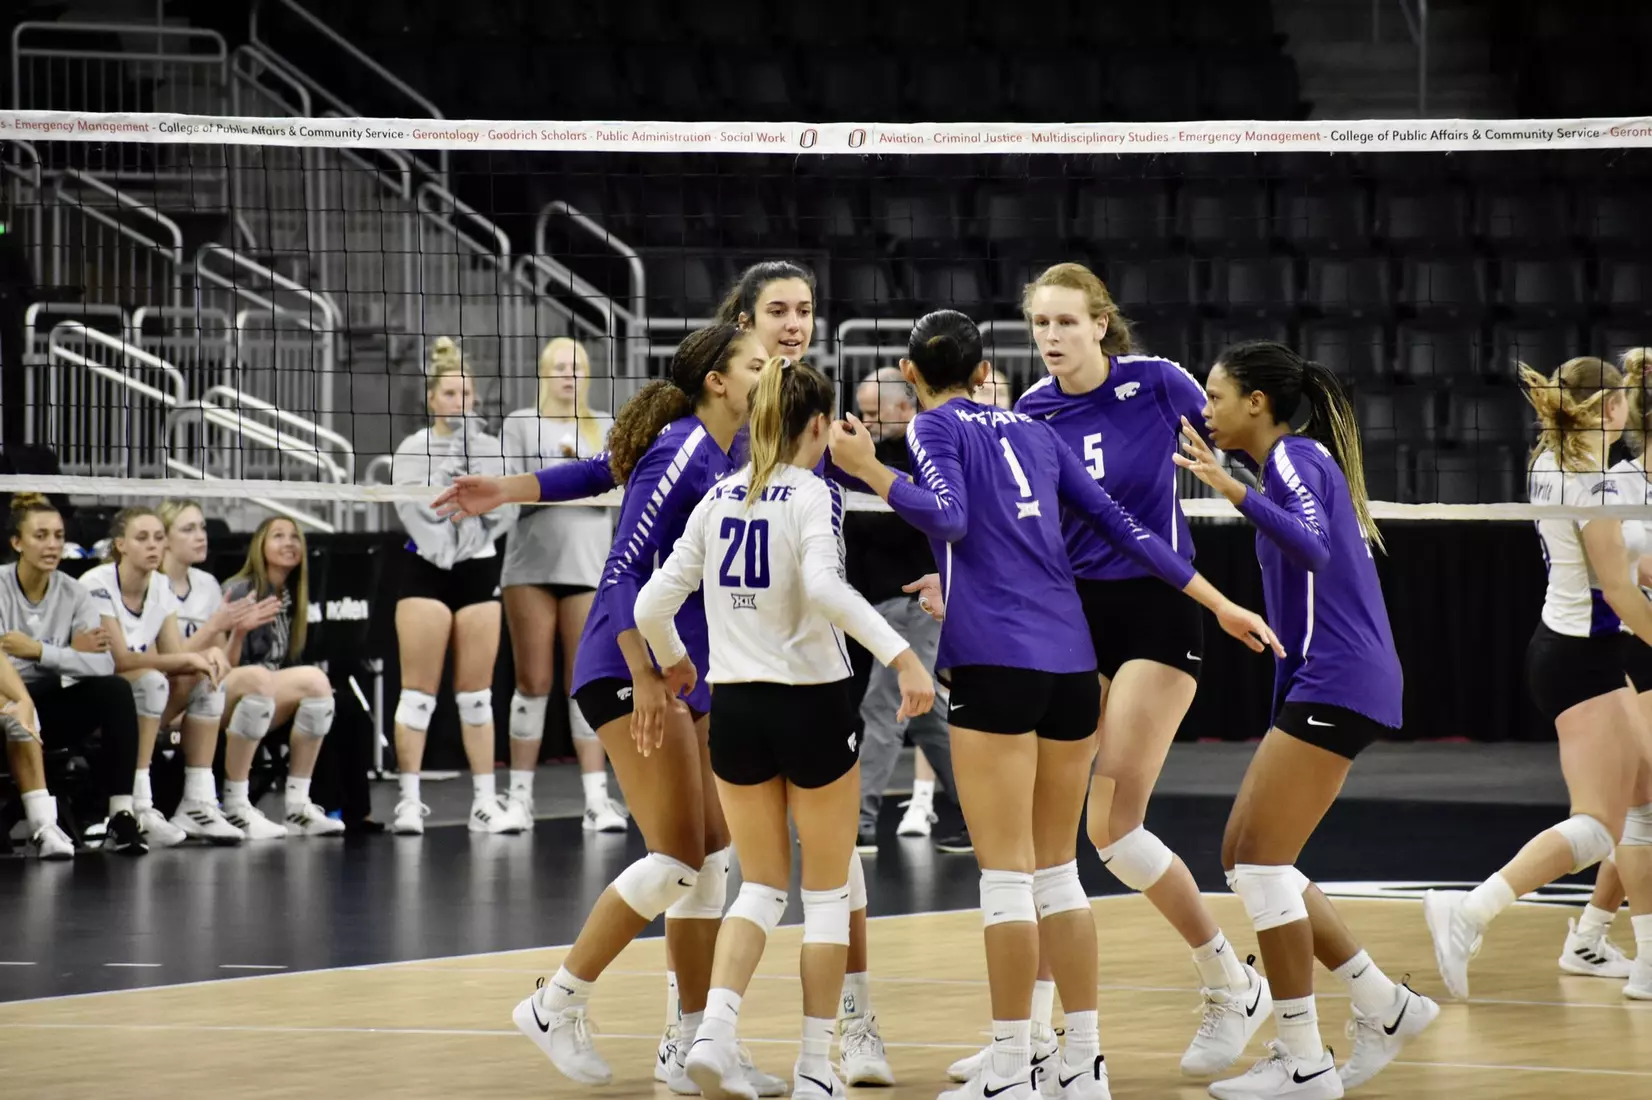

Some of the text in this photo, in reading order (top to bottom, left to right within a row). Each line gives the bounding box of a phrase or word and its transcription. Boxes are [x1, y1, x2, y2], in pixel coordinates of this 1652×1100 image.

[15, 118, 75, 133] Emergency
[77, 119, 149, 134] Management
[159, 121, 200, 136] College
[202, 123, 214, 134] of
[216, 123, 250, 135] Public
[251, 125, 287, 137] Affairs
[288, 126, 297, 137] &
[299, 126, 363, 141] Community
[365, 127, 404, 140] Service
[412, 129, 480, 144] Gerontology
[487, 129, 538, 142] Goodrich
[540, 129, 588, 142] Scholars
[596, 130, 629, 142] Public
[631, 130, 712, 143] Administration
[720, 131, 754, 143] Social
[756, 132, 786, 143] Work
[879, 132, 924, 144] Aviation
[933, 132, 981, 144] Criminal
[983, 132, 1023, 144] Justice
[1031, 131, 1126, 146] Multidisciplinary
[1128, 131, 1169, 143] Studies
[1178, 130, 1242, 145] Emergency
[1245, 130, 1321, 145] Management
[1330, 129, 1374, 144] College
[1377, 130, 1389, 141] of
[1392, 130, 1428, 142] Public
[1430, 129, 1469, 141] Affairs
[1471, 128, 1482, 140] &
[1485, 128, 1554, 142] Community
[1557, 127, 1600, 139] Service
[1000, 436, 1032, 497] 1
[1083, 432, 1106, 480] 5
[719, 516, 770, 588] 20
